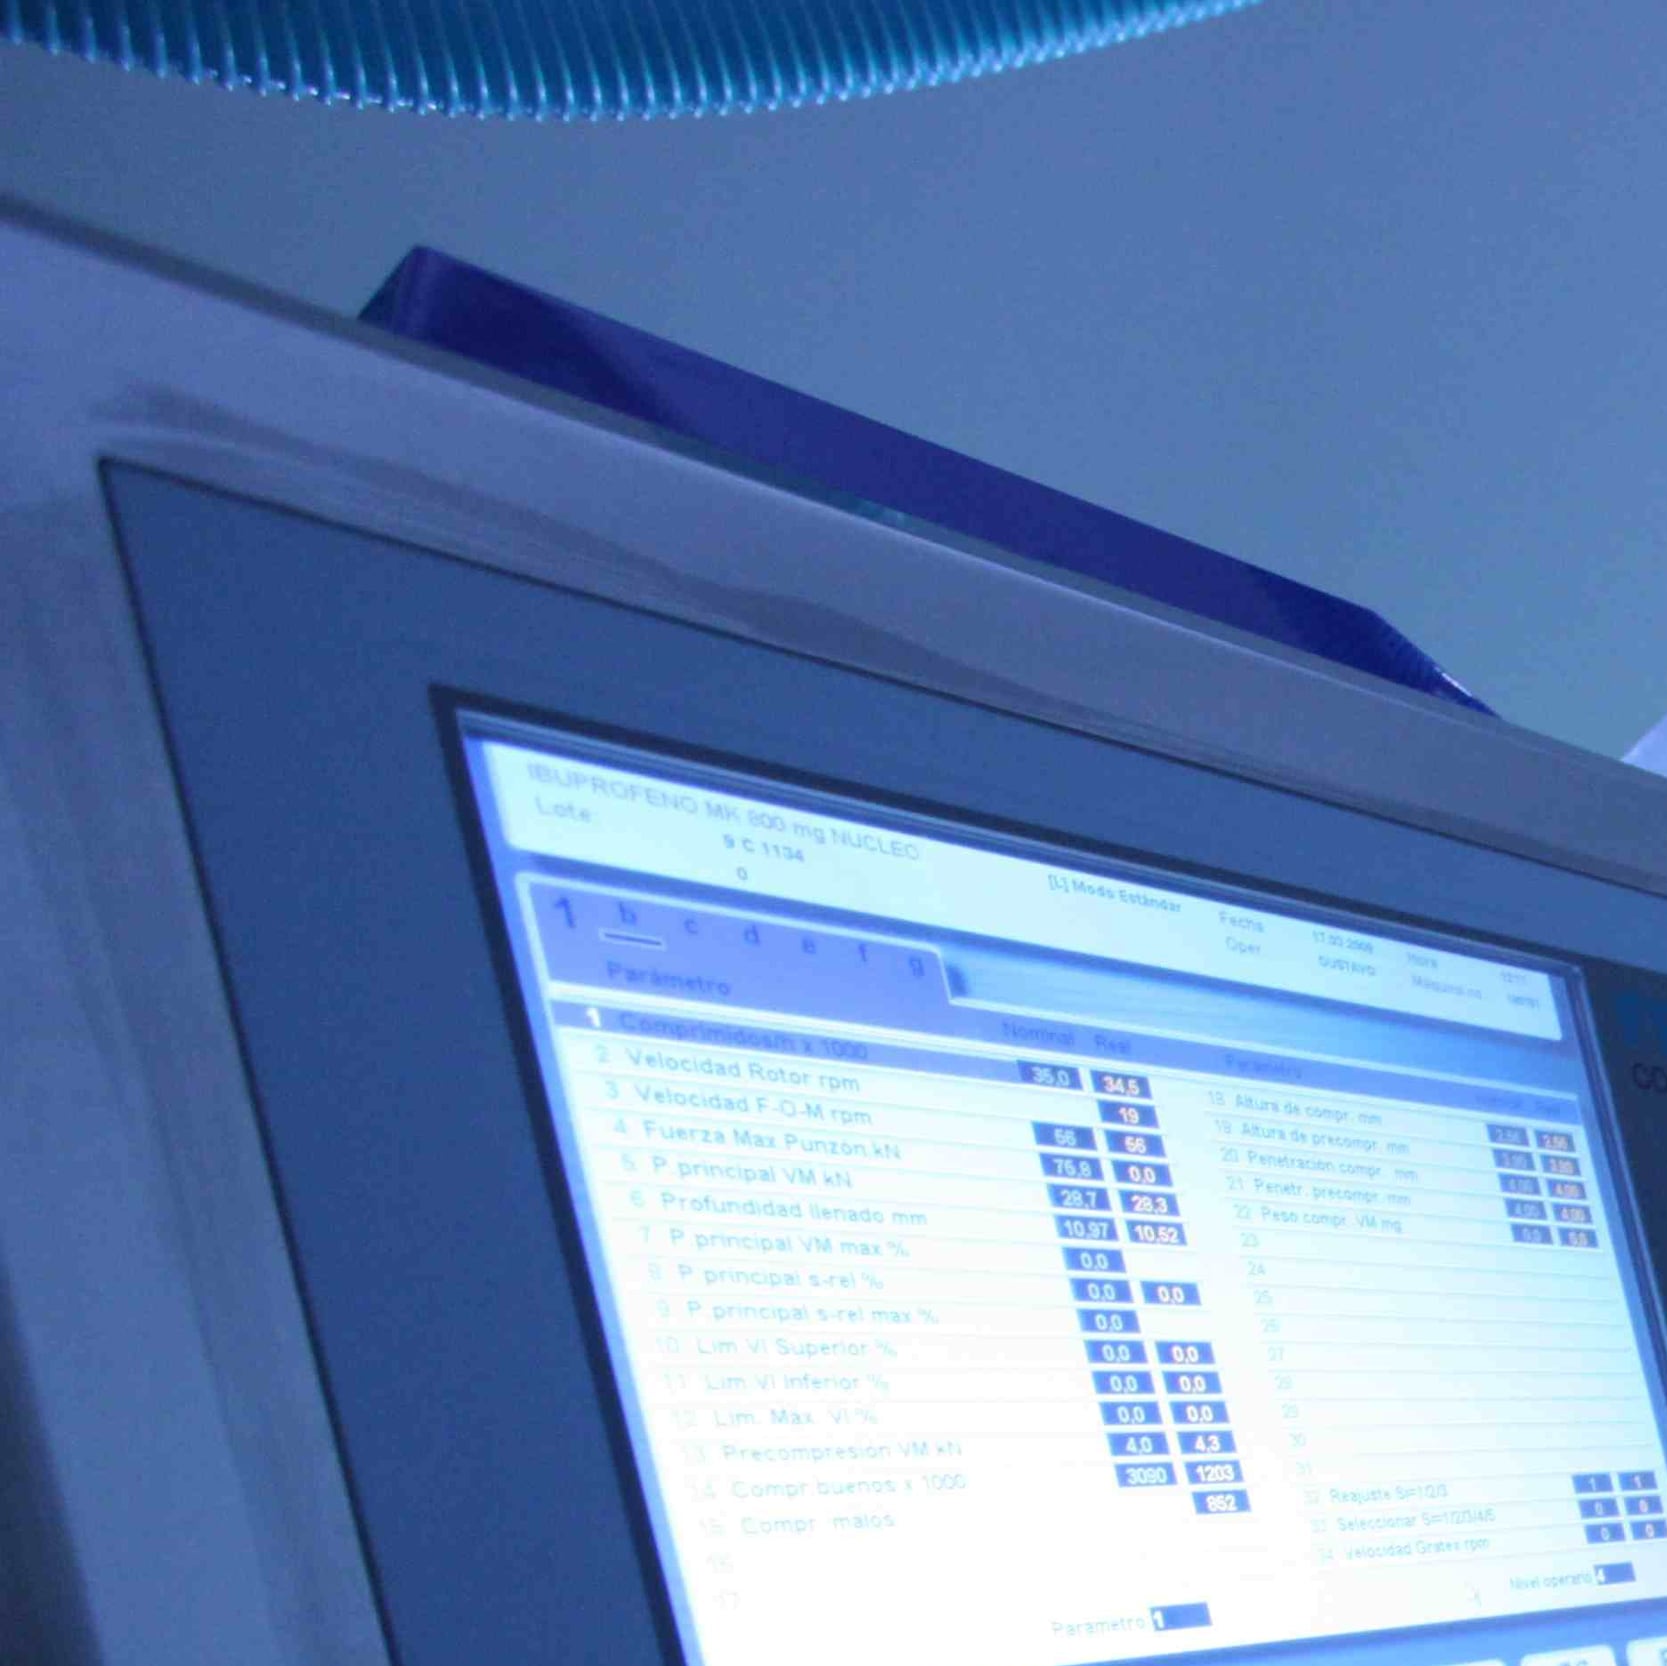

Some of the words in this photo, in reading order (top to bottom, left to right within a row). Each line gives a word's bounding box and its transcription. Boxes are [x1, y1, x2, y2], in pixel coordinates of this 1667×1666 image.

[526, 763, 699, 817] IBUPROFENO
[791, 820, 826, 845] mg
[550, 895, 577, 930] 1
[617, 902, 638, 926] b
[682, 918, 700, 937] c
[741, 923, 761, 946] d
[626, 1048, 743, 1079] Velocidad
[747, 1062, 811, 1086] Rotor
[816, 1073, 861, 1096] rpm
[635, 1084, 752, 1113] Velocidad
[829, 1107, 873, 1129] rpm
[1117, 1107, 1141, 1125] 19
[643, 1120, 726, 1146] Fuerza
[782, 1166, 817, 1186] VM
[660, 1191, 803, 1219] Profundidad
[808, 1201, 885, 1224] llenado
[892, 1211, 928, 1227] mm
[1063, 1219, 1112, 1241] 10,97
[1133, 1224, 1180, 1245] 10,52
[1156, 1286, 1186, 1304] 0,0
[1170, 1345, 1199, 1362] 0,0
[1177, 1375, 1207, 1392] 0,0
[1124, 1466, 1169, 1486] 3090
